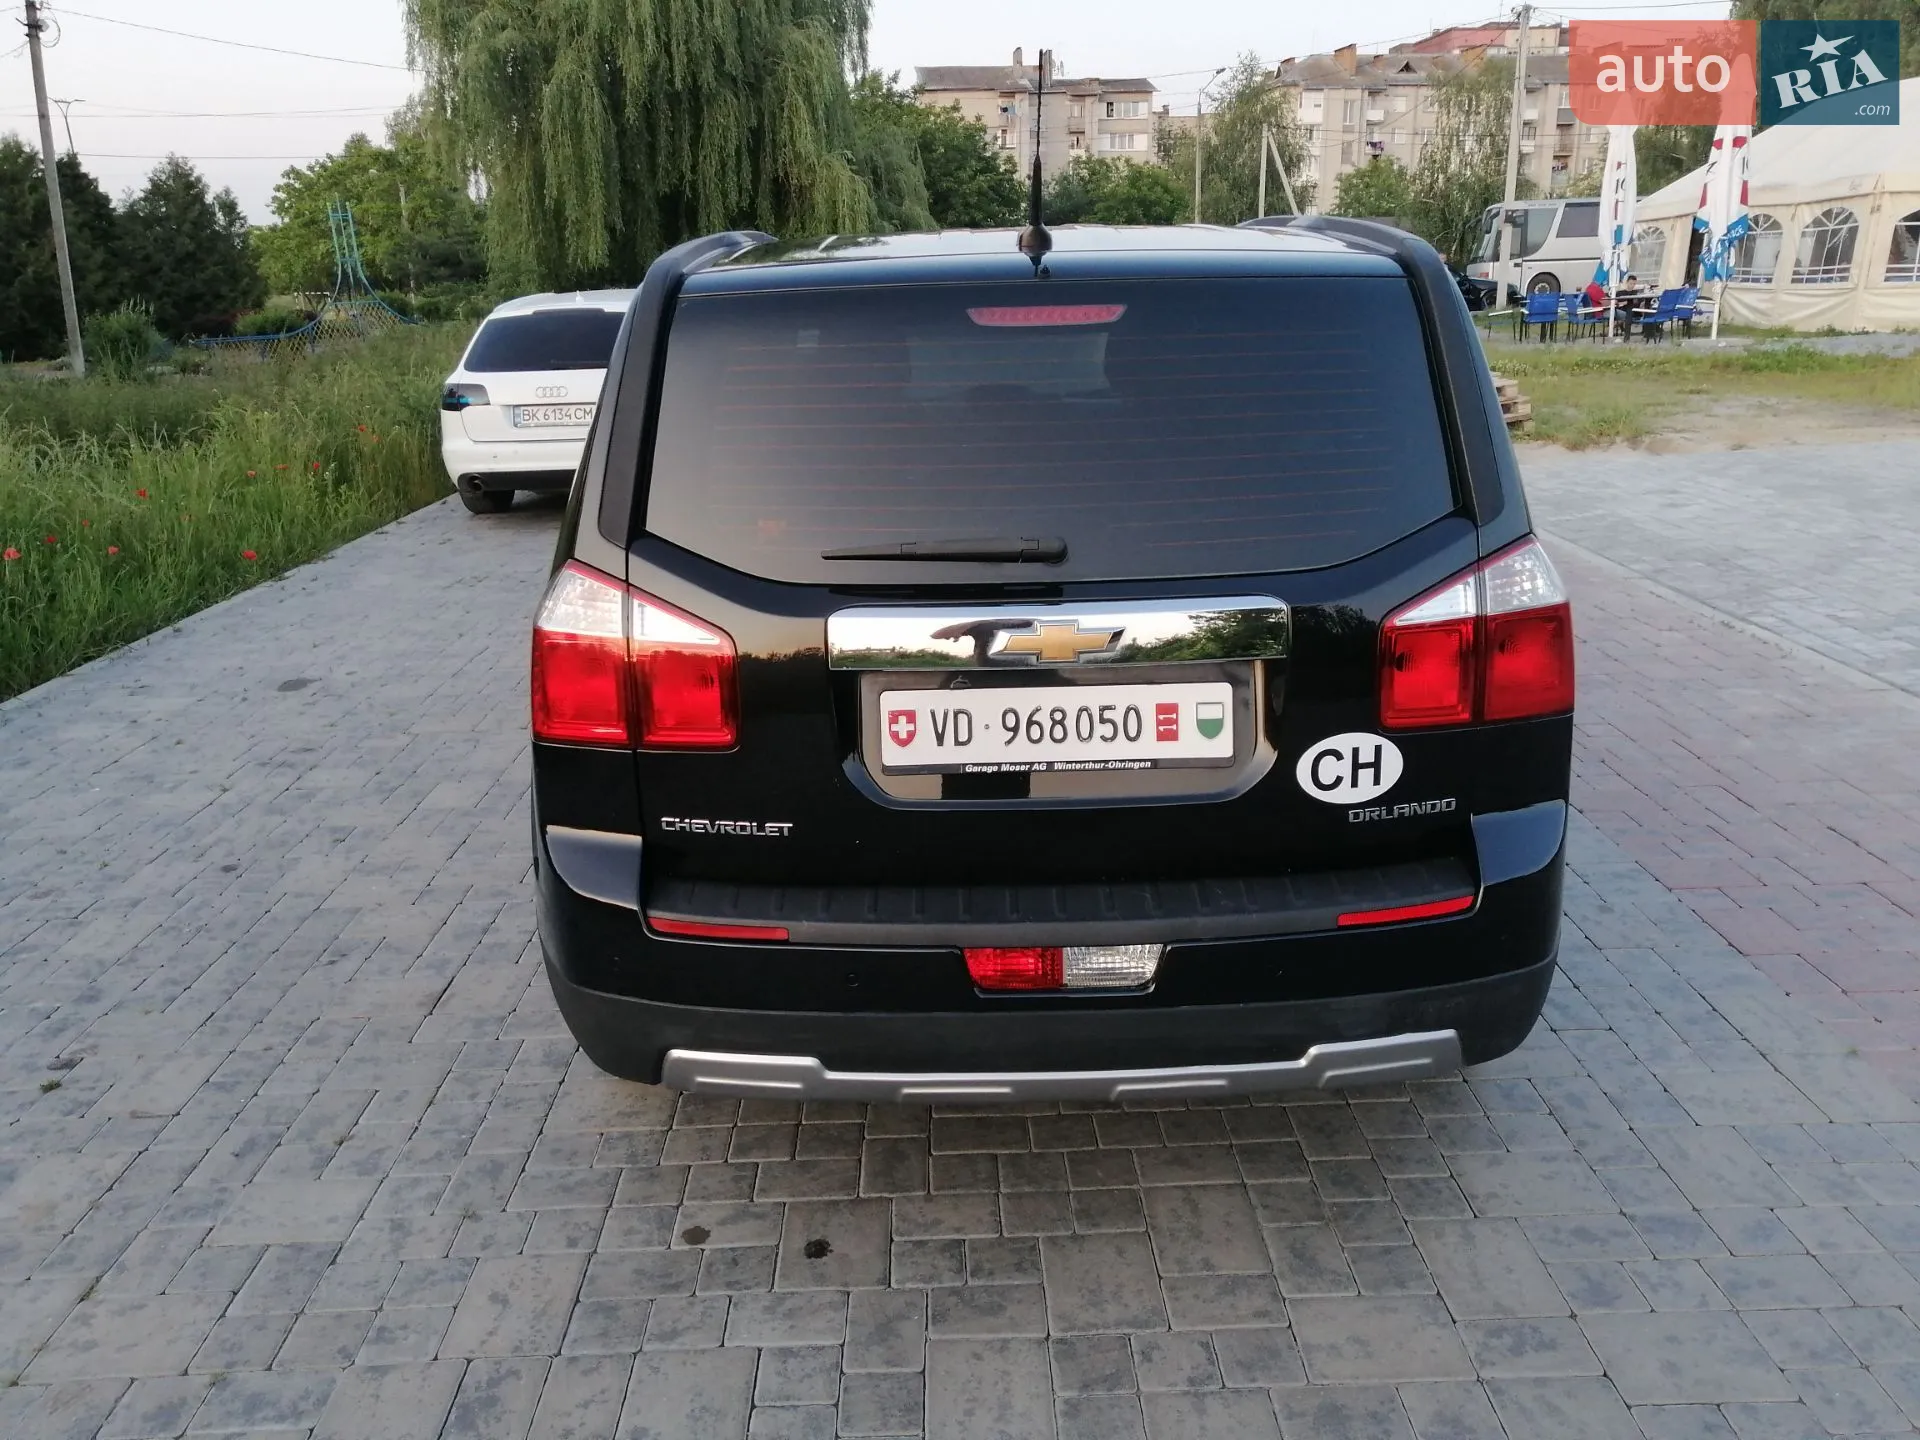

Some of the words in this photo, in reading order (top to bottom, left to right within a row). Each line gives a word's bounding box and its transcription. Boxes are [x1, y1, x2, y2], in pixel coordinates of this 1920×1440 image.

[522, 409, 540, 422] BK
[543, 407, 572, 421] 6134
[574, 407, 593, 420] CM
[929, 708, 972, 747] VD
[1001, 703, 1143, 747] 968050
[965, 764, 998, 773] Garage
[1001, 763, 1029, 772] Moser
[1031, 762, 1047, 771] AG
[1054, 760, 1151, 771] Winterthur-Ohringen
[1310, 744, 1383, 792] CH
[1348, 798, 1456, 823] ORLANDO
[661, 817, 793, 837] CHEVROLET
